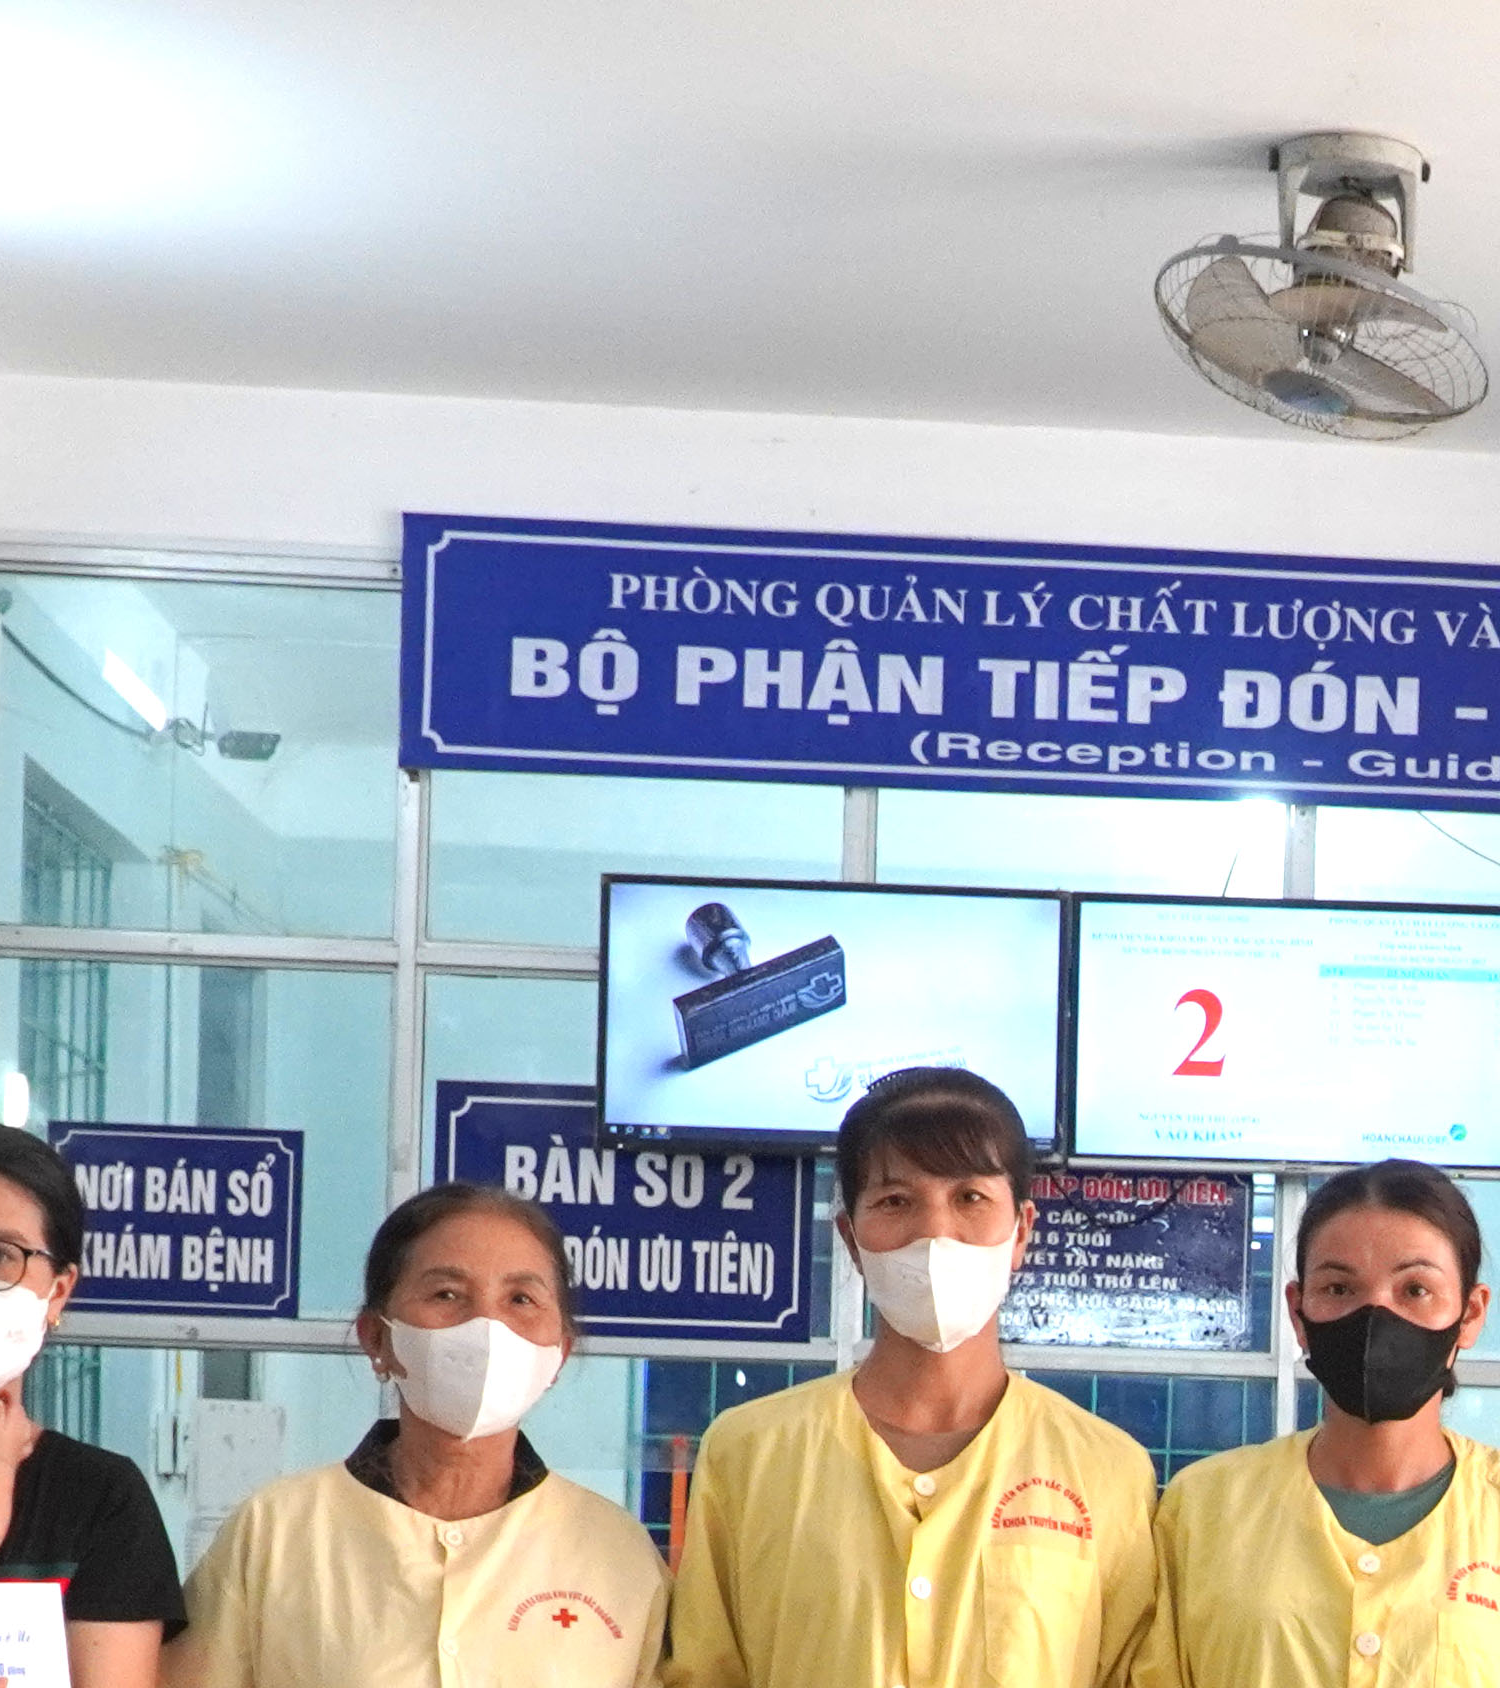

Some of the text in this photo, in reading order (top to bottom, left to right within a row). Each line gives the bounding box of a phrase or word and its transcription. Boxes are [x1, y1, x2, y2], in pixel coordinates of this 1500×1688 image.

[609, 567, 801, 617] PHÒNG
[816, 573, 966, 627] QUẢN
[984, 582, 1050, 629] LÝ
[1069, 581, 1219, 637] CHẤT
[1232, 600, 1416, 654] LƯỢNG
[510, 629, 639, 716] BỘ
[675, 639, 945, 725] PHẬN
[978, 645, 1188, 725] TIẾP
[1220, 661, 1421, 737] ĐÓN
[1455, 706, 1488, 721] -
[910, 730, 1277, 774] (Reception
[1302, 758, 1320, 767] -
[1172, 988, 1227, 1078] 2
[75, 1153, 275, 1217] NƠI BÁN SỔ
[504, 1133, 616, 1205] BÀN
[721, 1154, 754, 1210] 2
[181, 1226, 275, 1292] BỆNH
[639, 1233, 682, 1292] ƯU
[692, 1229, 775, 1301] TIÊN)
[1047, 1231, 1060, 1246] 6
[1138, 1273, 1180, 1292] LÊN
